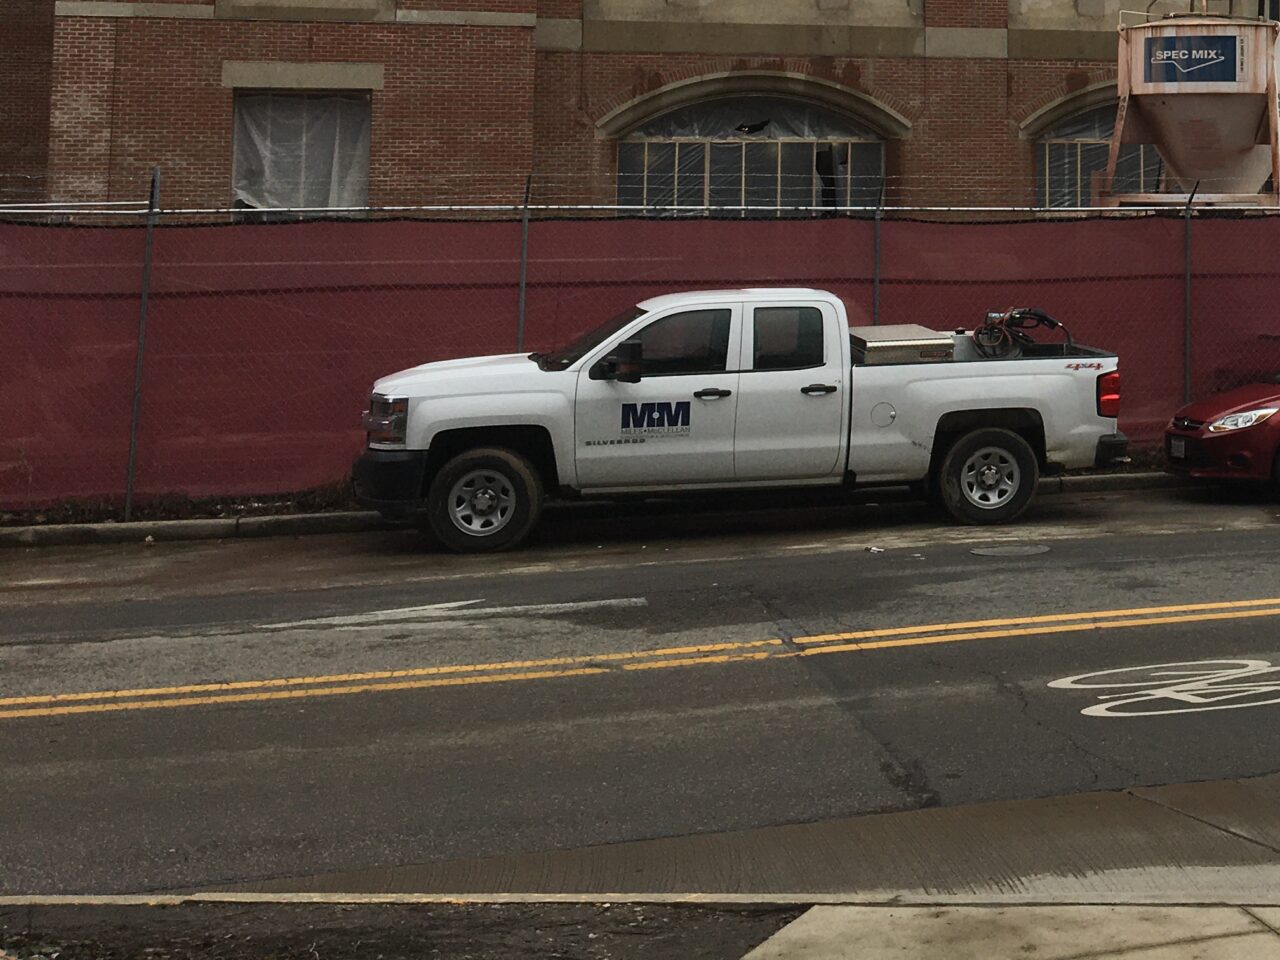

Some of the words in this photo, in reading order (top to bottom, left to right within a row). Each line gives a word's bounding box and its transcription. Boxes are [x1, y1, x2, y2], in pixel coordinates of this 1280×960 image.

[1156, 49, 1189, 60] SPEC
[1191, 49, 1217, 59] MIX
[584, 438, 646, 446] SILVERADO
